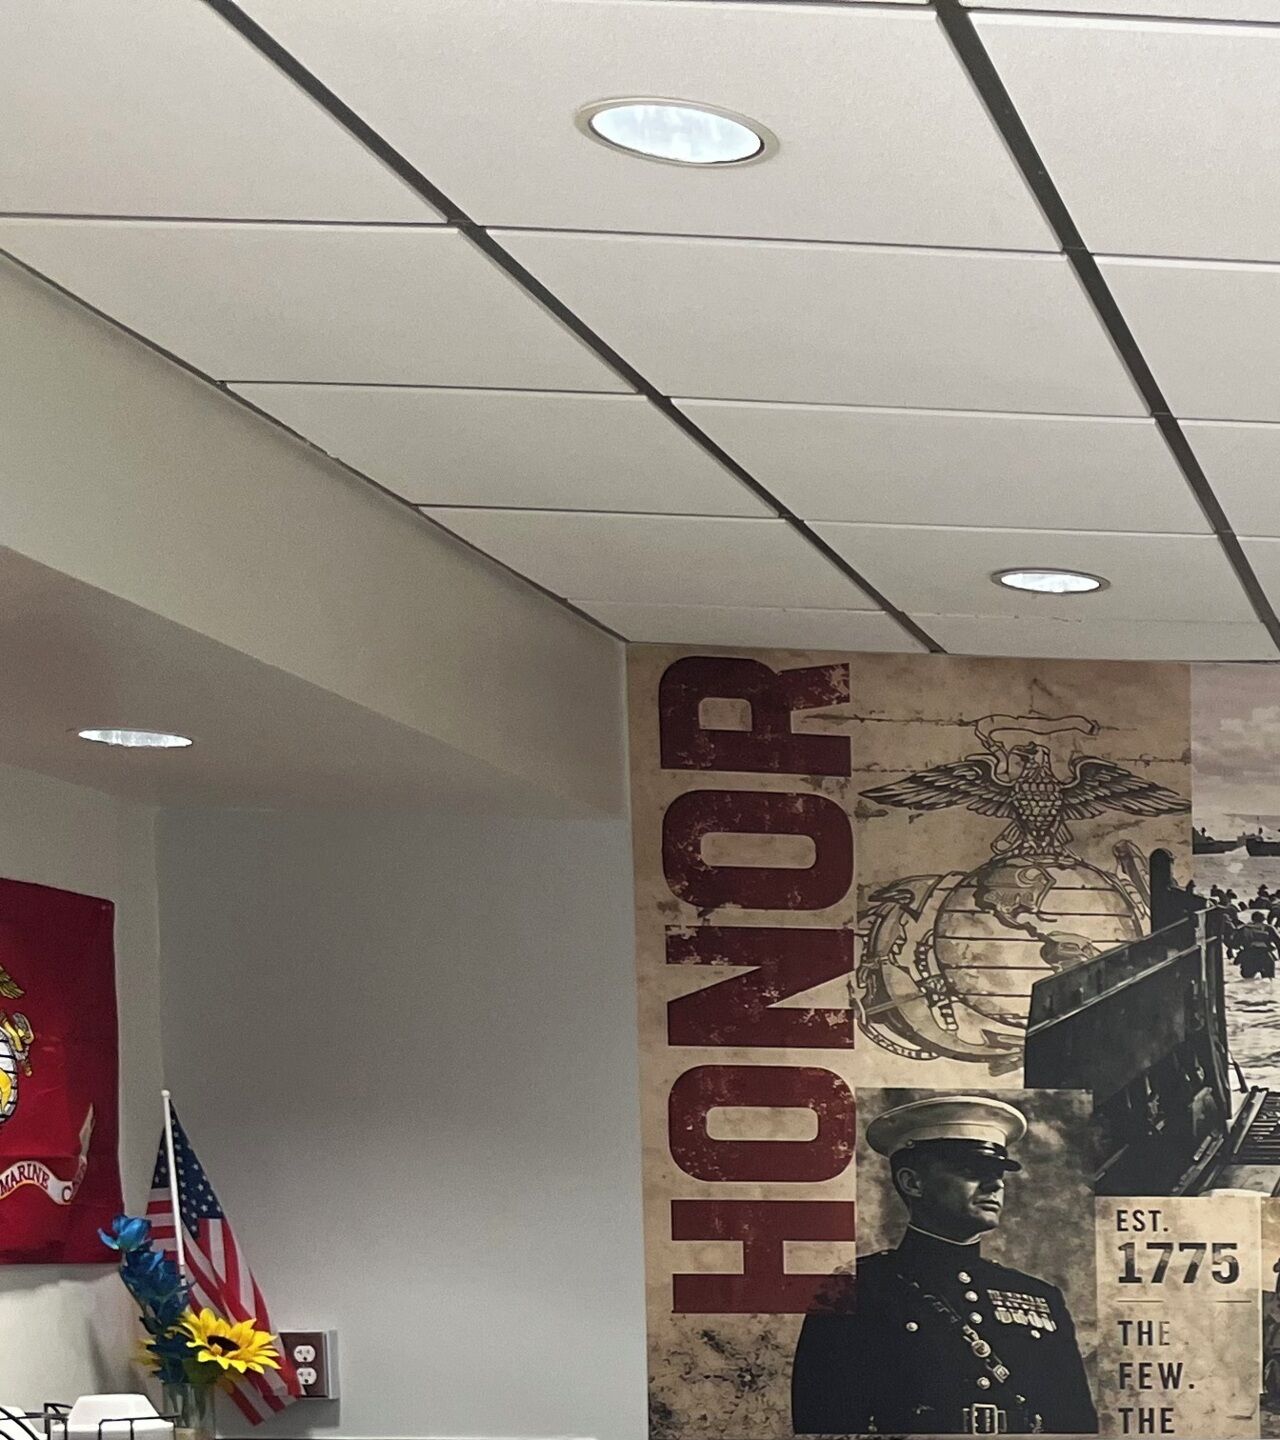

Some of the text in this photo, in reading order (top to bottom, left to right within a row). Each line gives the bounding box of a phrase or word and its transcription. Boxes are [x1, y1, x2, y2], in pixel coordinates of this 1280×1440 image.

[658, 654, 857, 1314] HONOR
[0, 1163, 50, 1196] MARINE
[1117, 1210, 1168, 1232] EST.
[1118, 1242, 1240, 1284] 1775
[1117, 1321, 1170, 1346] THE
[1119, 1363, 1194, 1390] FEW.
[1118, 1408, 1174, 1434] THE
